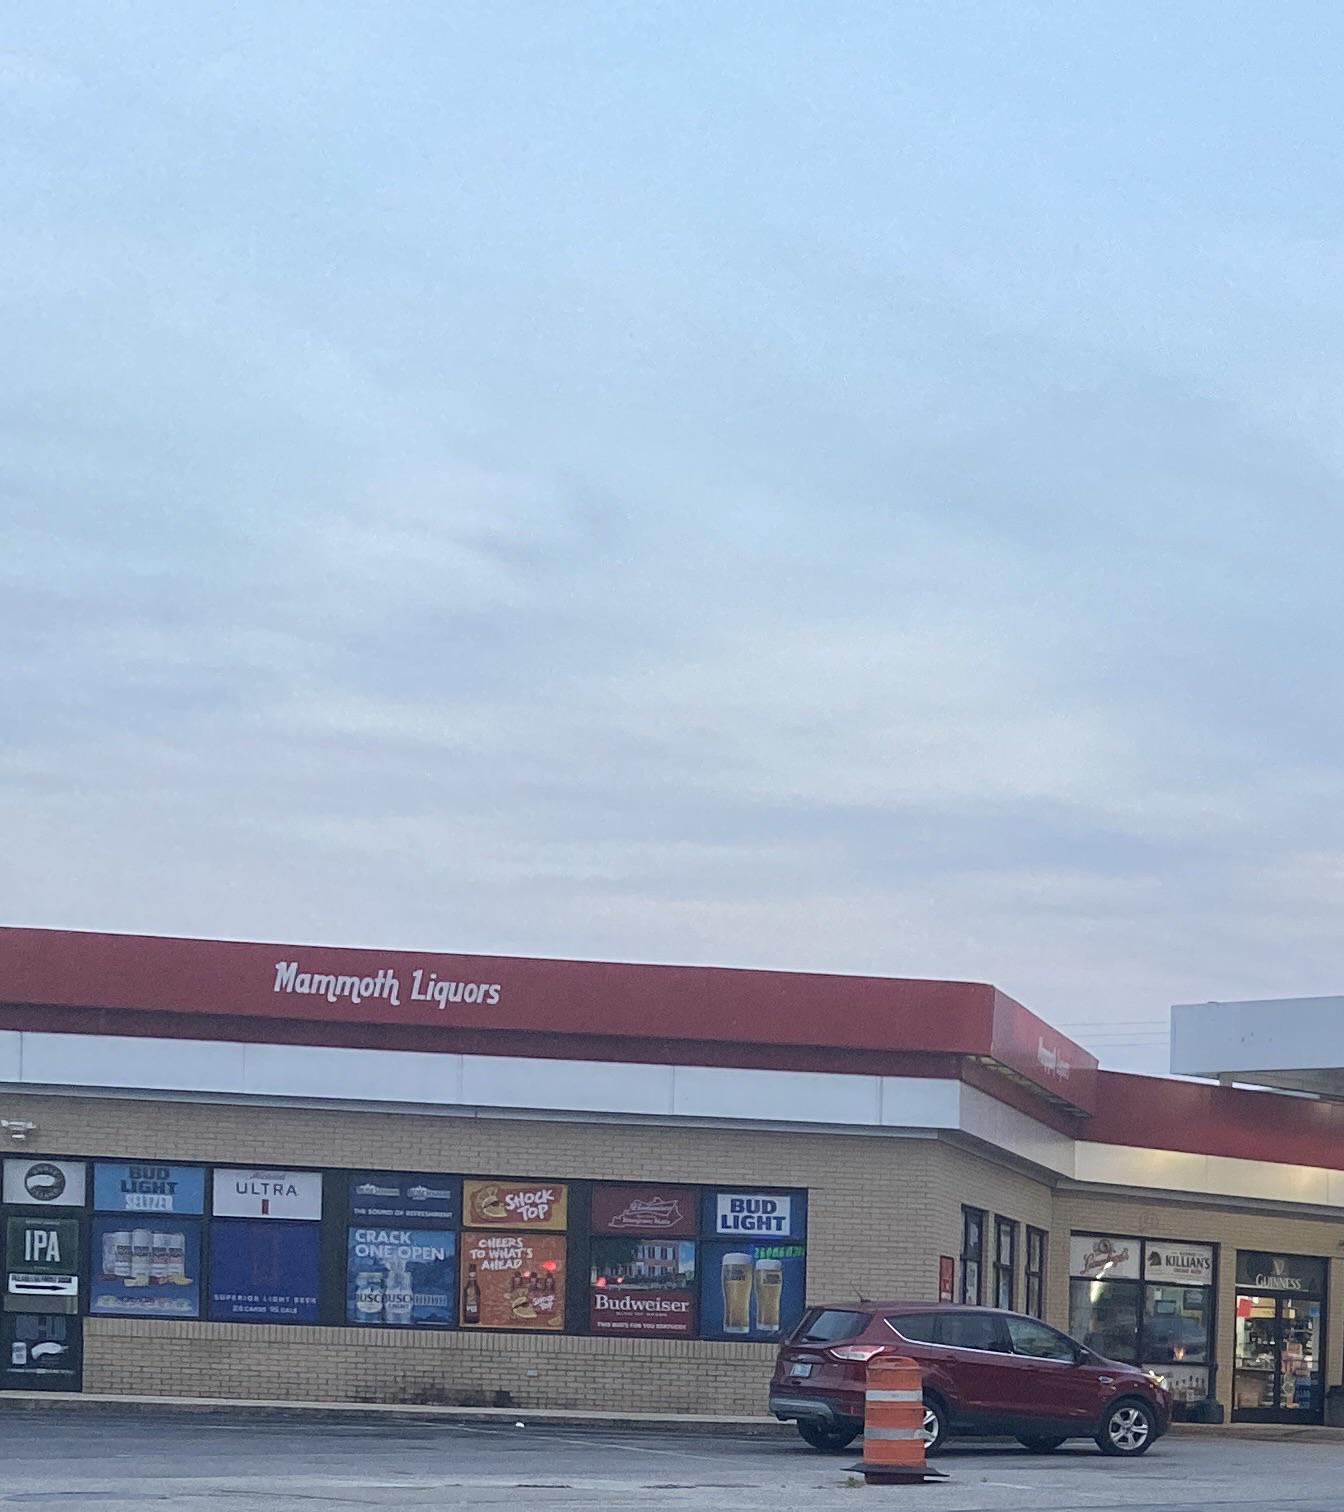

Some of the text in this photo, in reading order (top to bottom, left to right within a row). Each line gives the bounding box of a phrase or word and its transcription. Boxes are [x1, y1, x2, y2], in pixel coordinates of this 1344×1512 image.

[274, 961, 501, 1009] Mammoth Liquors
[129, 1166, 169, 1180] BUD
[121, 1180, 178, 1195] LIGHT
[235, 1182, 298, 1197] ULTRA
[505, 1189, 555, 1210] SHOCK
[730, 1198, 777, 1214] BUD
[517, 1204, 548, 1221] TOP
[721, 1214, 787, 1231] LIGHT
[355, 1229, 411, 1244] CRACK
[478, 1237, 523, 1248] CHEERS
[25, 1229, 61, 1262] IPA
[355, 1244, 445, 1261] ONE OPEN
[469, 1247, 533, 1259] TO WHAT'S
[480, 1259, 523, 1271] AHEAD
[1165, 1254, 1211, 1270] KILLIAN'S
[1255, 1273, 1302, 1290] GUINNESS
[214, 1294, 260, 1302] SUPERIOR
[594, 1294, 690, 1313] Budweiser
